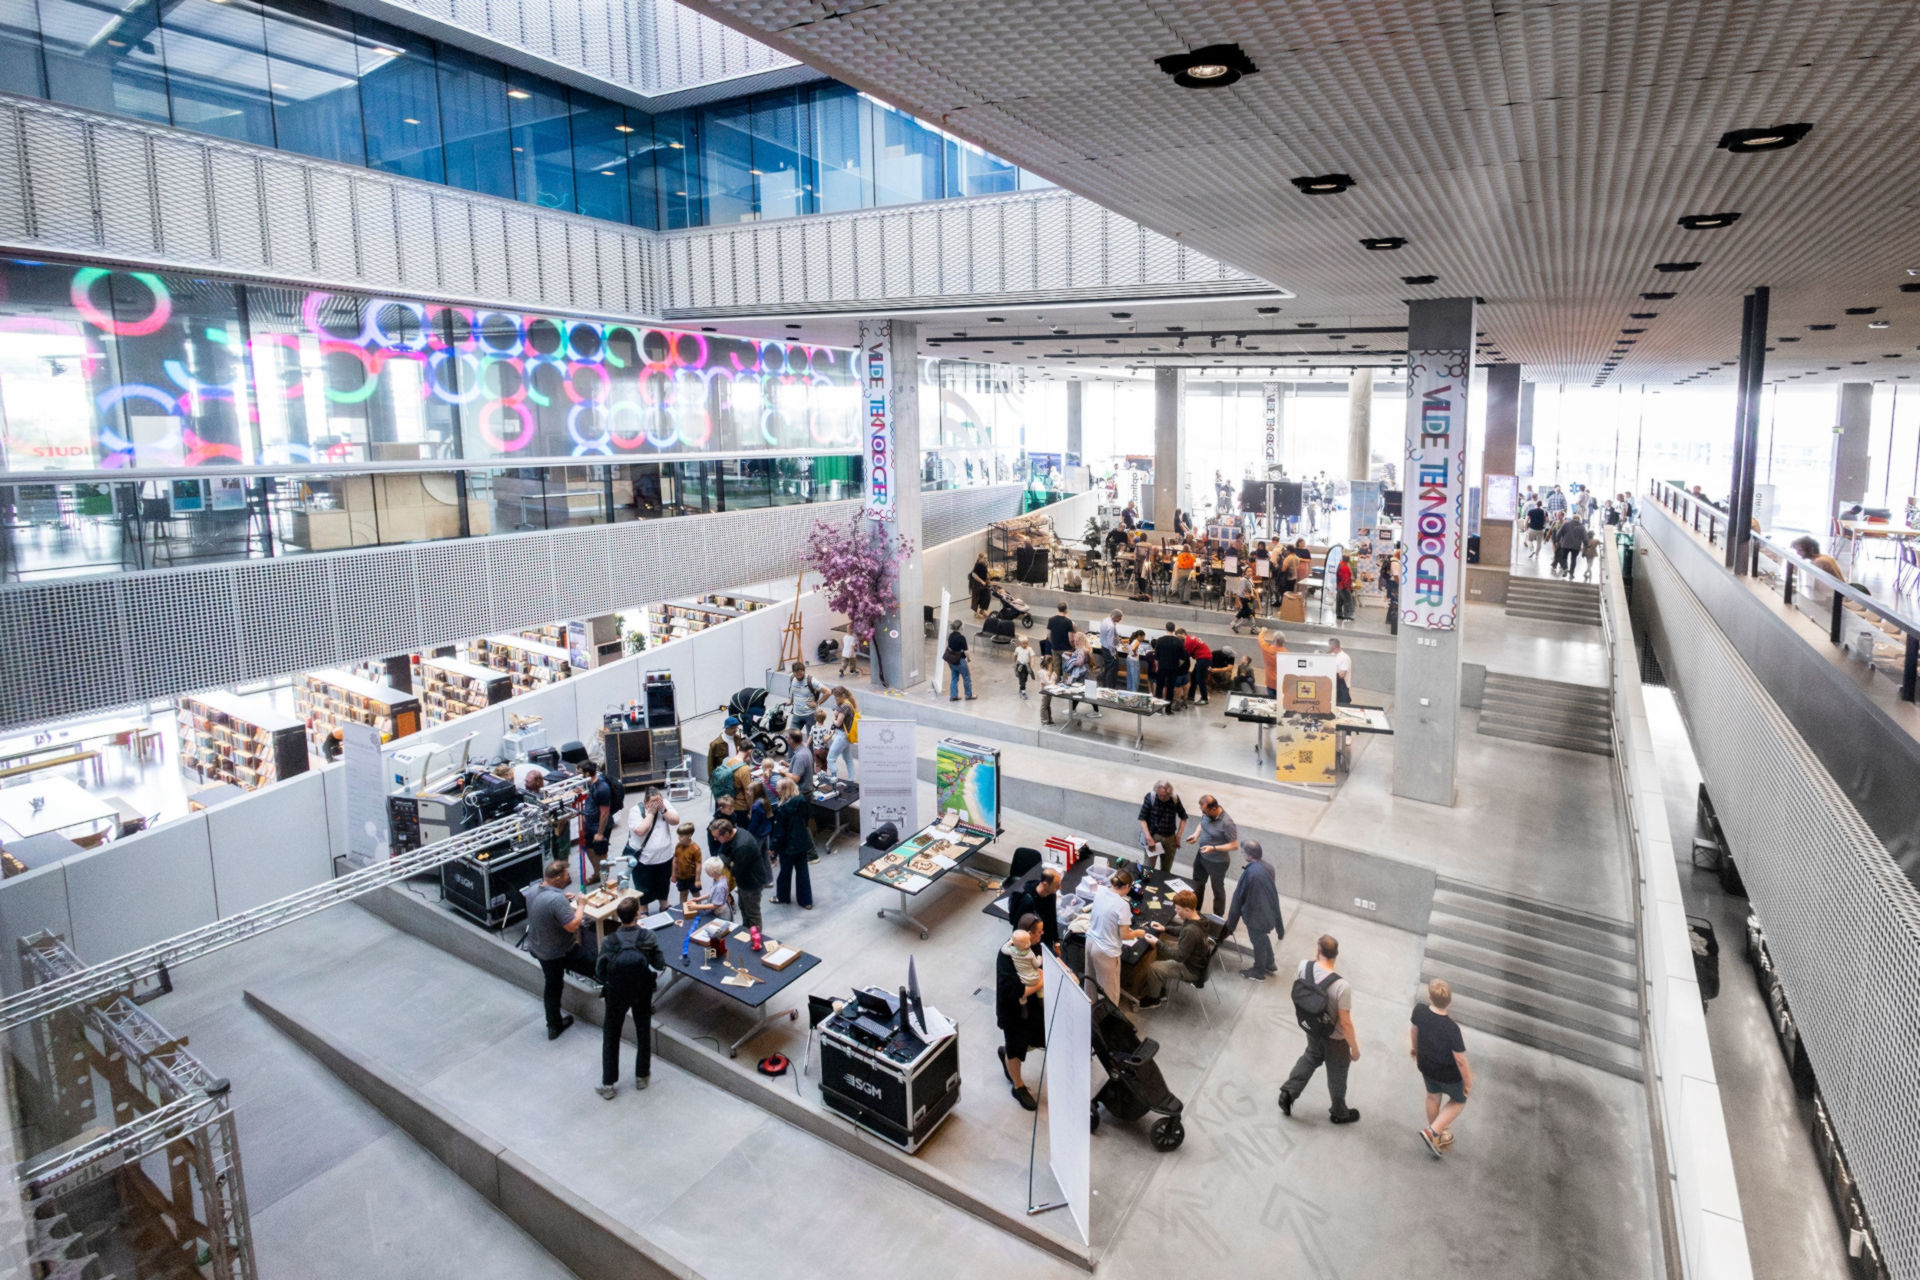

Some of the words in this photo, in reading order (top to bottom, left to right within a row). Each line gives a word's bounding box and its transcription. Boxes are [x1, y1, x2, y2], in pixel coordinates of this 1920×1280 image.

[868, 342, 884, 389] VILDE
[1421, 385, 1451, 449] VILDE
[1415, 457, 1448, 608] TEKNOLOGIER
[853, 1078, 882, 1101] SGM
